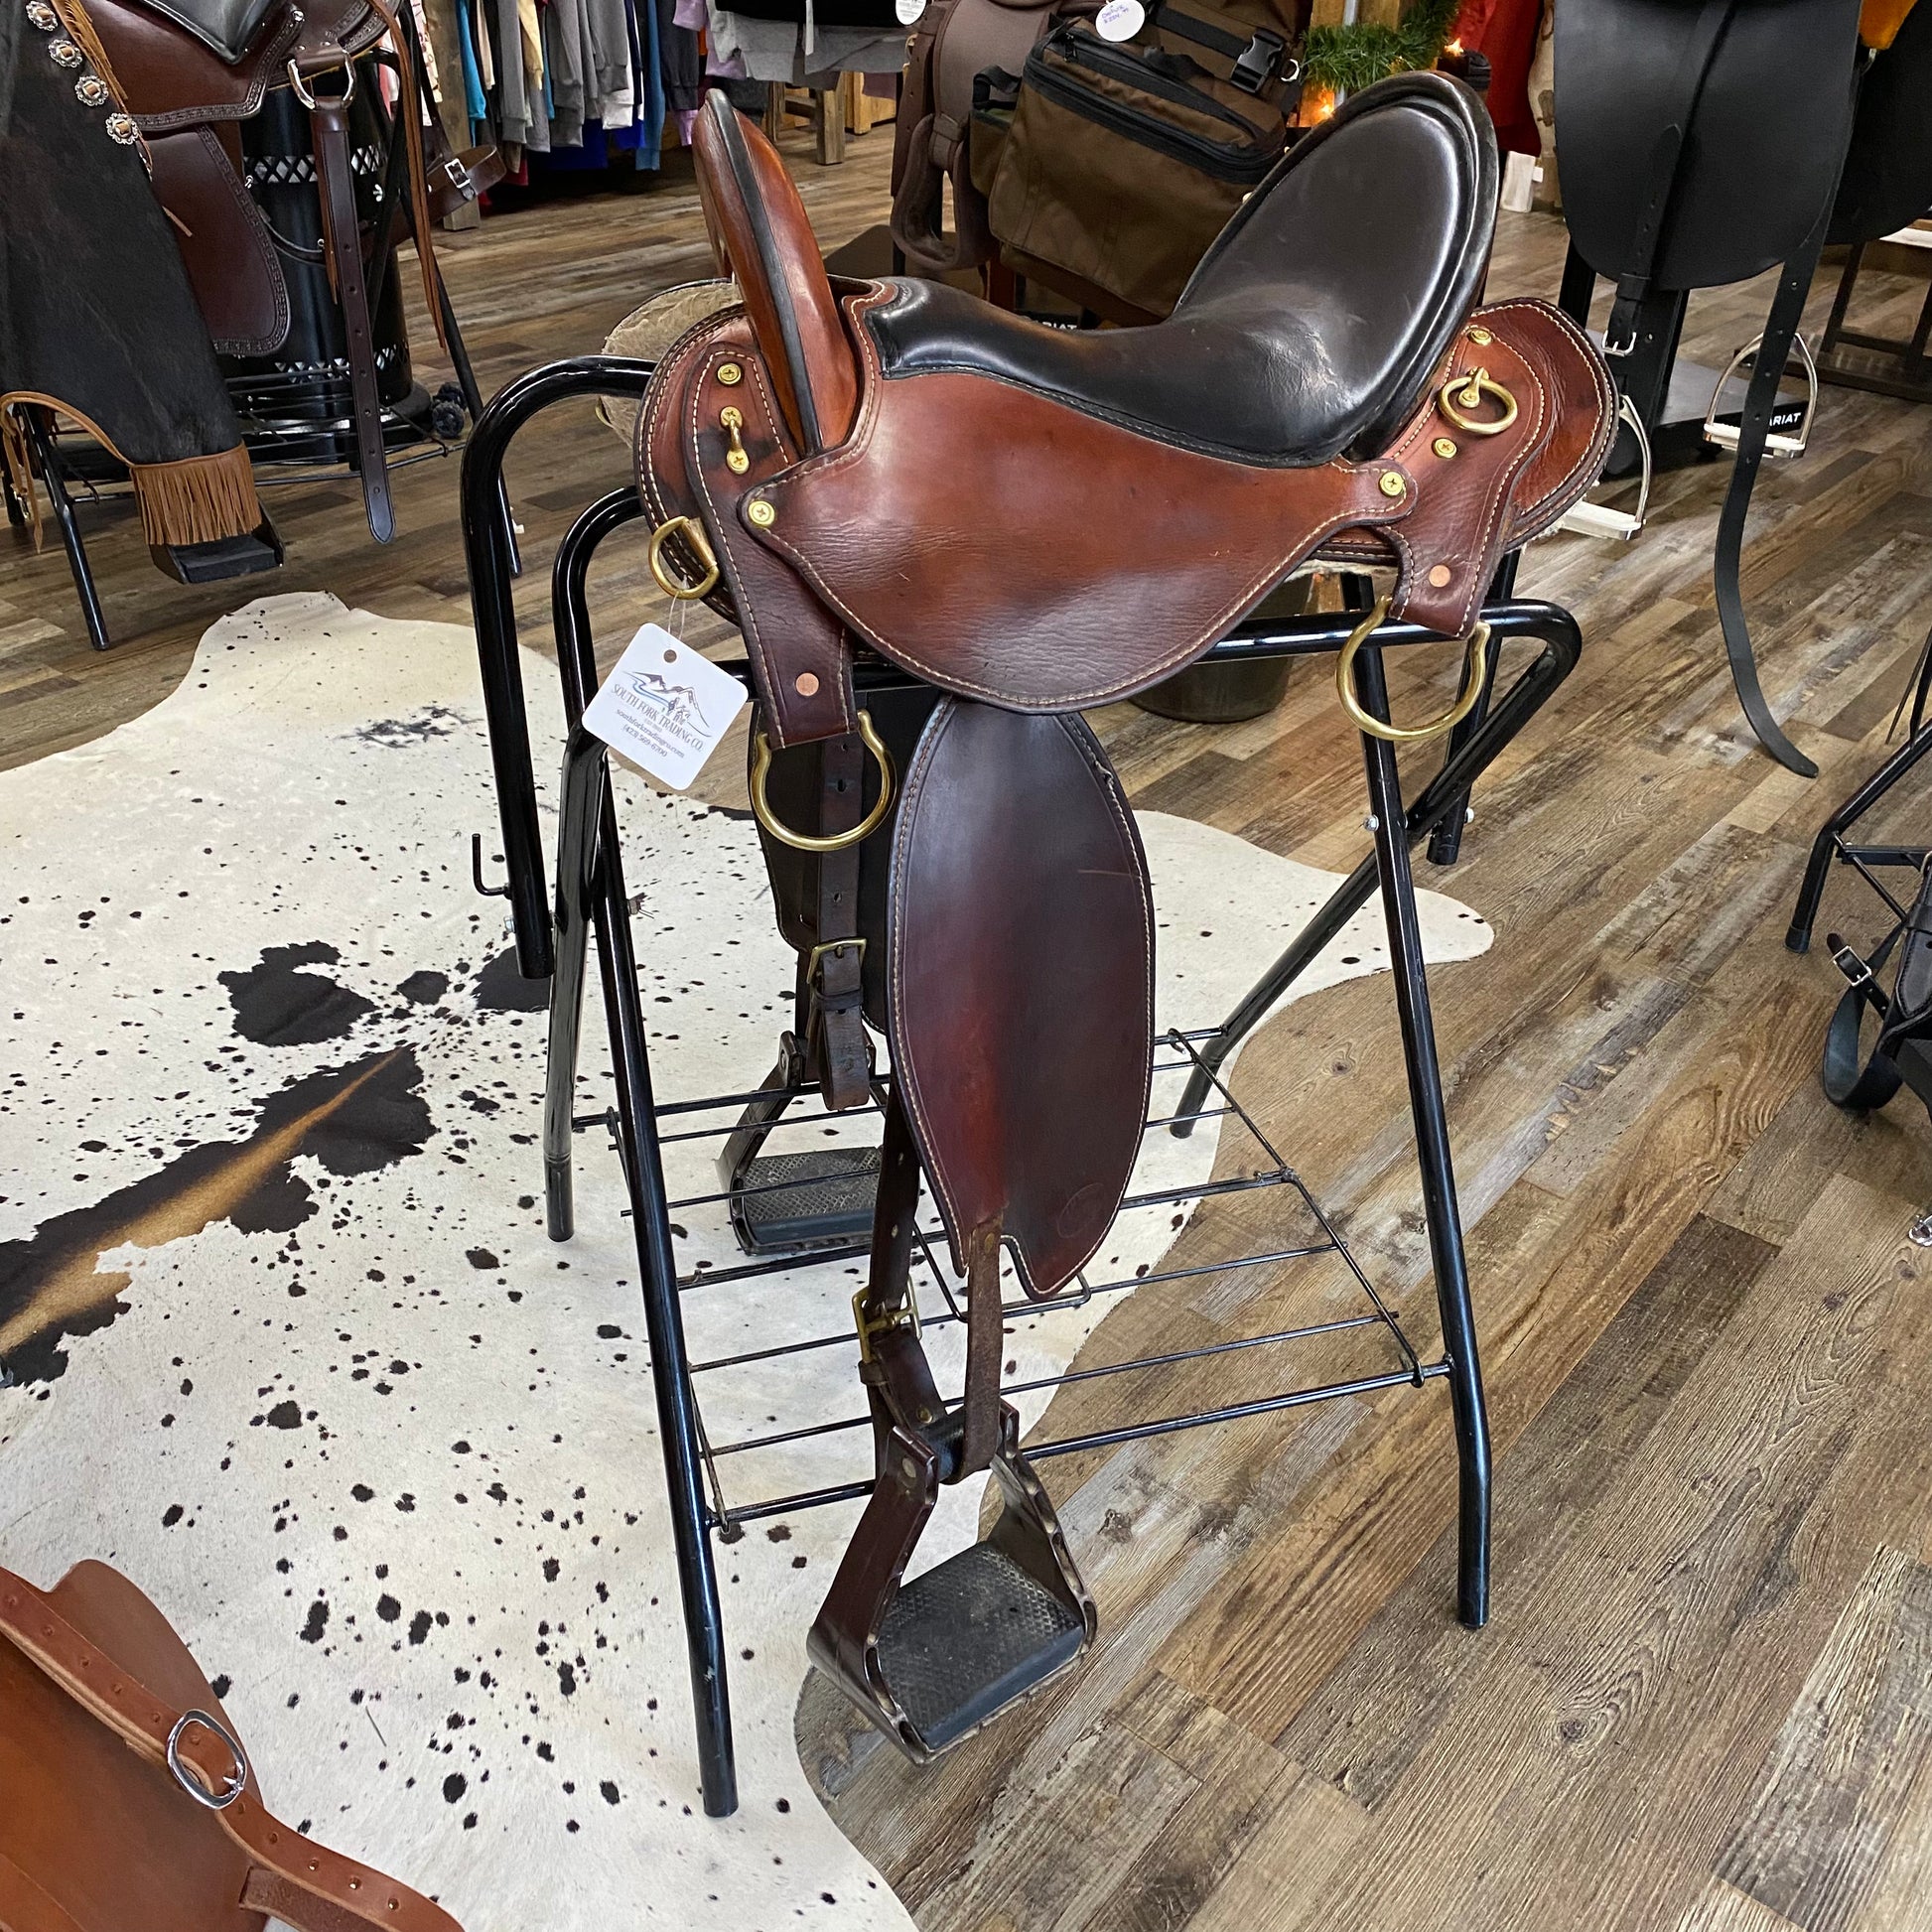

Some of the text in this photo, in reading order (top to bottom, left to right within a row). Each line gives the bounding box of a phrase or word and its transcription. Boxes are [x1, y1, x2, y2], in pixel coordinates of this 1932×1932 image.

[612, 683, 638, 706] SOUTH
[636, 700, 659, 720] FORK
[657, 715, 691, 744] TRADING
